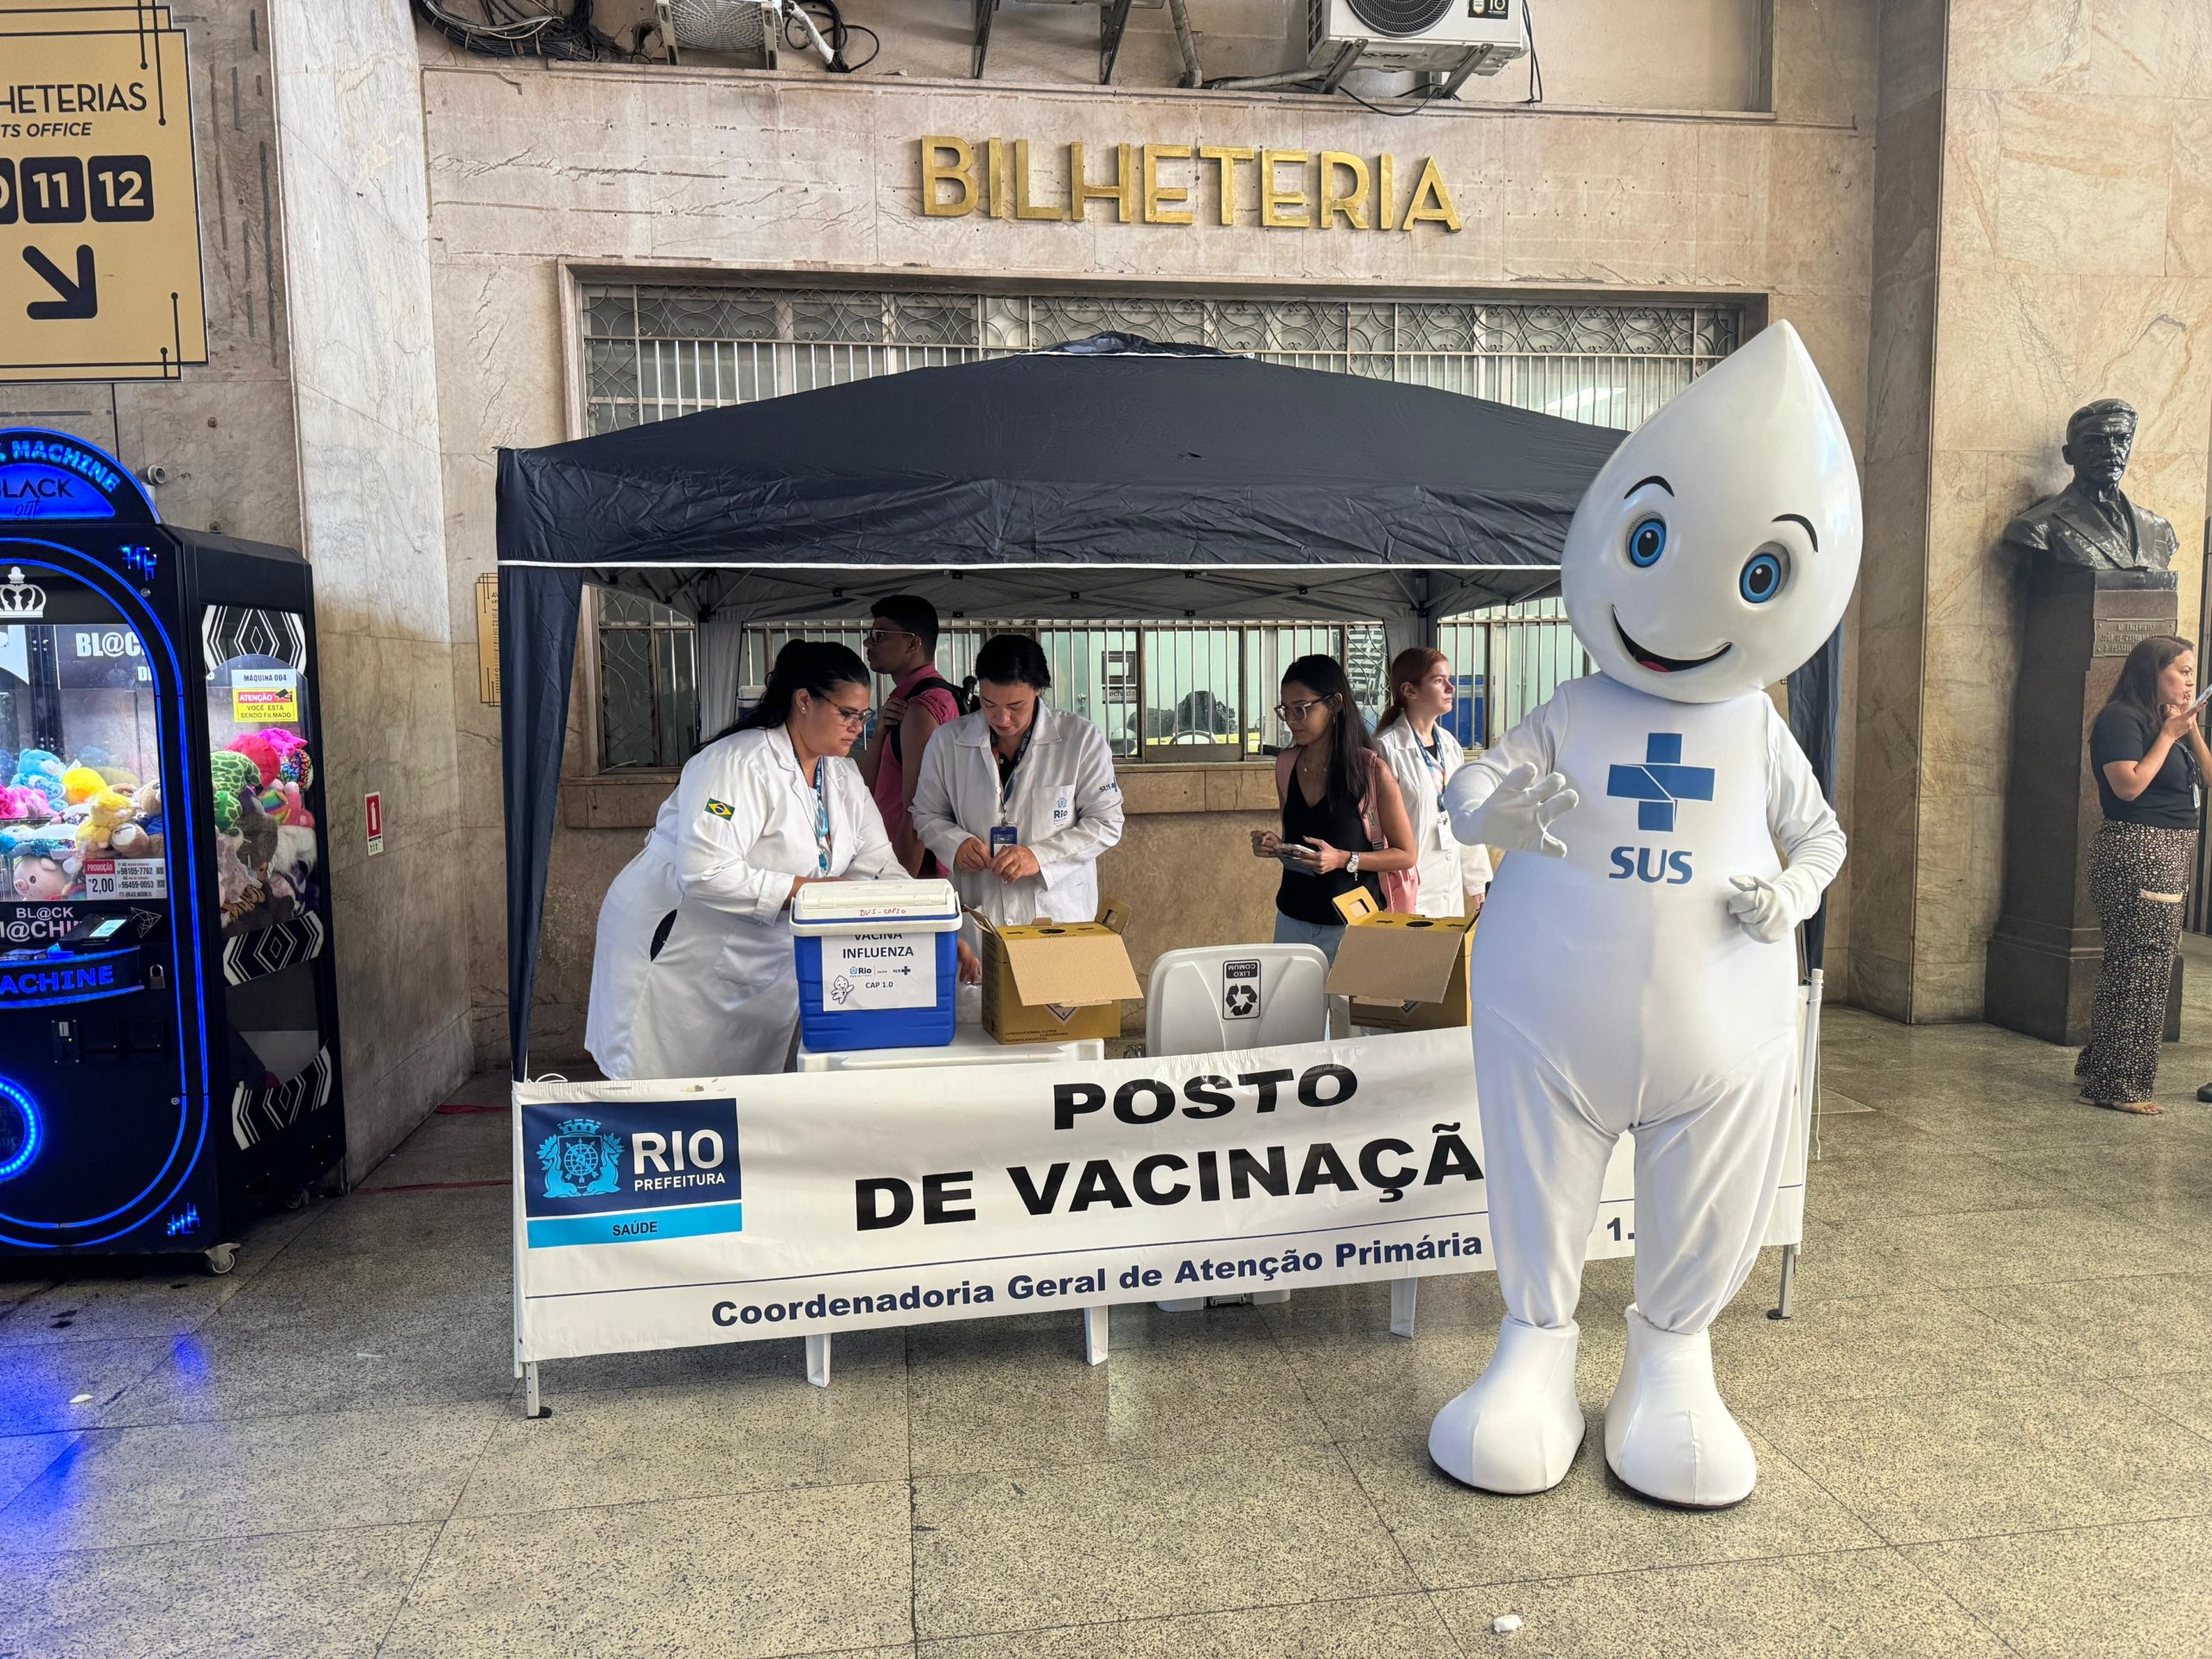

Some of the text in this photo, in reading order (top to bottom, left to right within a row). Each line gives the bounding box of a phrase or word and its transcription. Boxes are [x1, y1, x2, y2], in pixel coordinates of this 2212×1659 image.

[27, 122, 92, 137] OFFICE
[32, 172, 69, 208] 11
[98, 170, 145, 207] 12
[920, 135, 1462, 232] BILHETERIA
[11, 440, 121, 493] MACHINE
[0, 478, 74, 499] LACK
[76, 632, 146, 657] BL@C
[244, 674, 273, 683] MÁQUINA
[239, 693, 273, 702] ATENÇÃO
[1099, 784, 1111, 792] SUS
[1053, 810, 1068, 819] Rio
[87, 862, 113, 873] PROMOÇÃO
[1609, 846, 1693, 884] SUS
[92, 878, 114, 895] 2,00
[16, 906, 74, 920] BL@CK
[0, 920, 82, 943] @CHI
[842, 946, 914, 959] INFLUENZA
[1053, 1063, 1358, 1130] POSTO
[632, 1129, 724, 1175] RIO
[634, 1173, 726, 1192] PREFEITURA
[855, 1122, 1484, 1231] DE VACINAÇÃ
[613, 1220, 658, 1236] SAÚDE
[711, 1217, 1634, 1327] Coordenadoria Geral de Atenção Primária 1.
